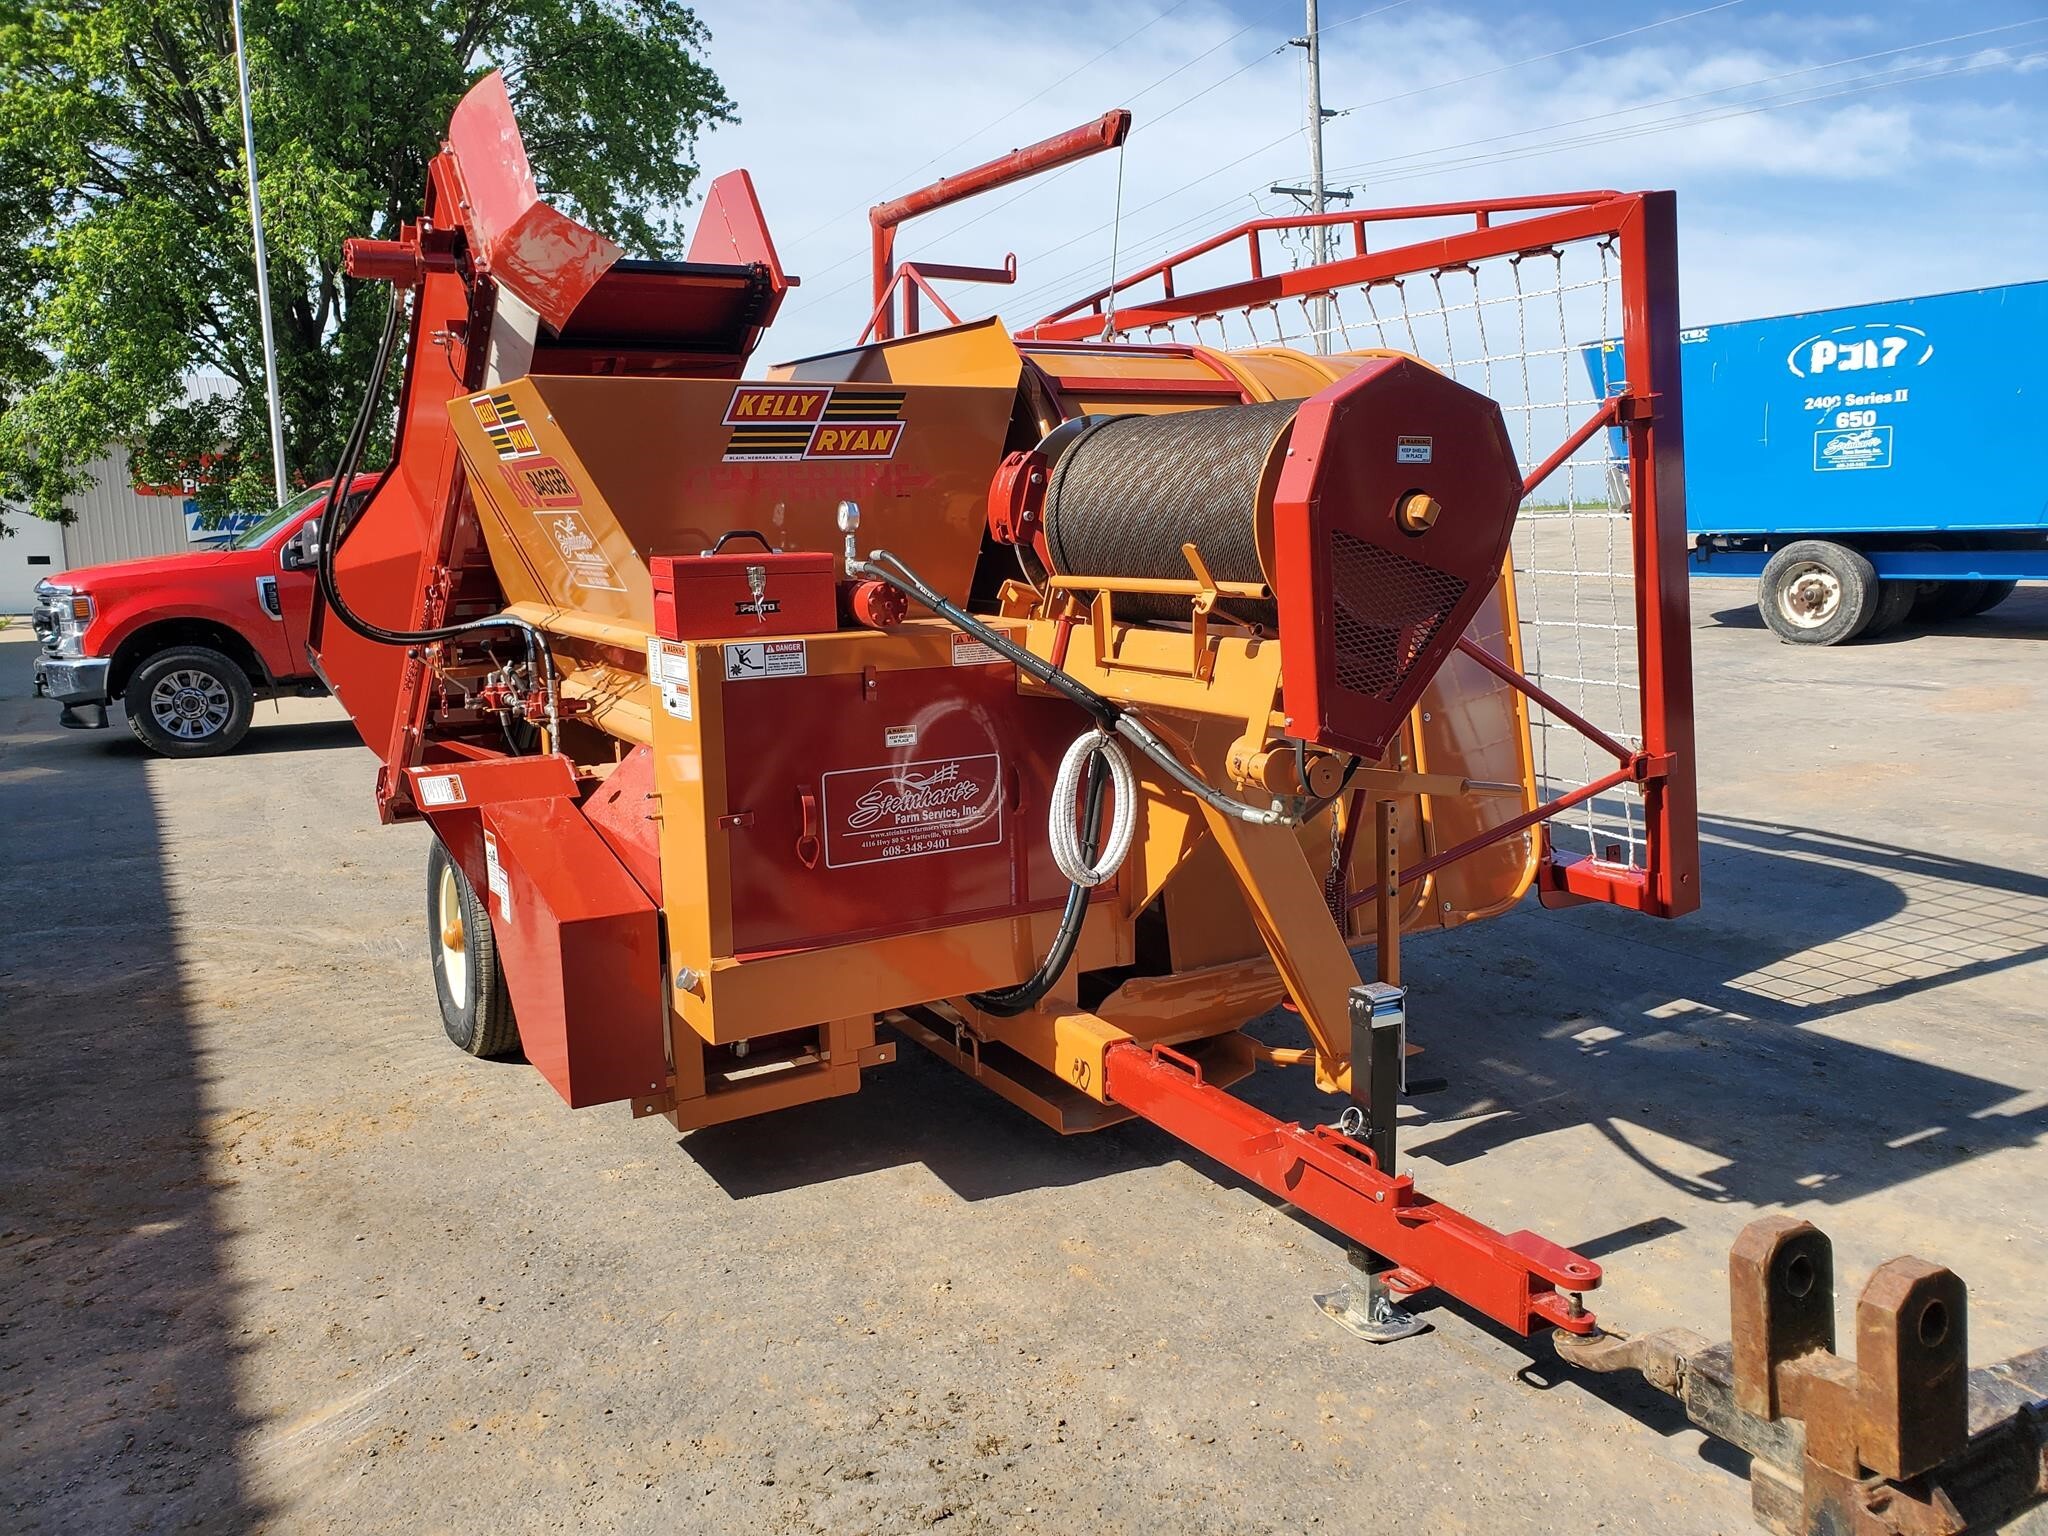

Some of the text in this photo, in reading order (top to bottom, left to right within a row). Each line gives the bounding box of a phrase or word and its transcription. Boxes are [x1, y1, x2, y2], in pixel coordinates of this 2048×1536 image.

[736, 395, 819, 416] KELLY
[1845, 391, 1892, 406] Series
[1894, 389, 1909, 402] II
[475, 403, 497, 424] KELLY
[1836, 410, 1877, 428] 650
[508, 428, 534, 449] RYAN
[815, 429, 893, 451] RYAN
[526, 468, 574, 496] BAGGER
[775, 643, 801, 652] DANGER
[848, 780, 980, 829] Steinhart's
[895, 804, 980, 825] Farm Service, Inc.
[877, 840, 890, 848] Hwy
[911, 832, 942, 841] Platteville,
[882, 838, 950, 857] 608-348-9401
